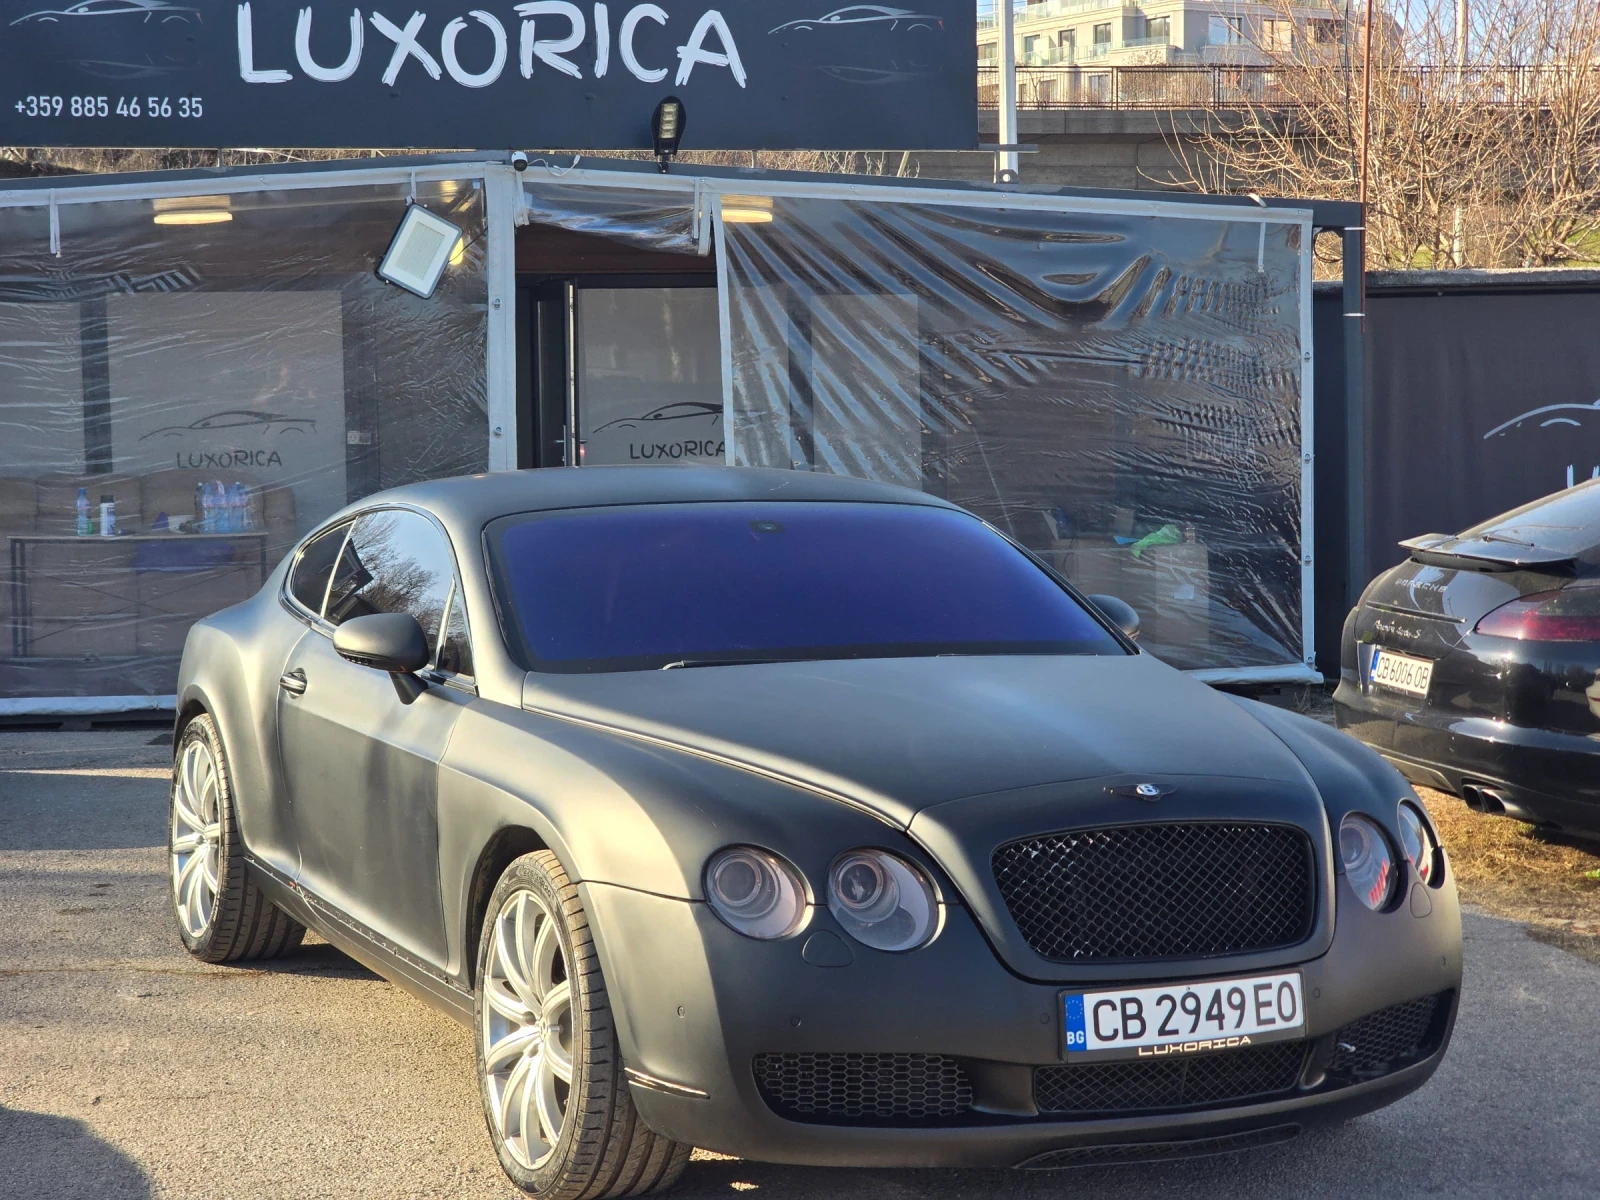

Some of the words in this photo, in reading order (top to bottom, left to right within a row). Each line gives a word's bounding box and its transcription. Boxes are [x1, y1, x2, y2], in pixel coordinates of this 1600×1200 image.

[237, 1, 748, 88] LUXORICA
[14, 95, 64, 117] +359
[70, 96, 109, 118] 885
[116, 96, 141, 118] 46
[148, 97, 172, 118] 56
[178, 97, 203, 118] 35
[176, 449, 283, 469] LUXORICA
[1394, 578, 1448, 593] PORSCHE
[1066, 1030, 1085, 1046] BG
[1092, 997, 1147, 1042] CB
[1155, 986, 1247, 1037] 2949
[1138, 1035, 1252, 1057] LUXORICA
